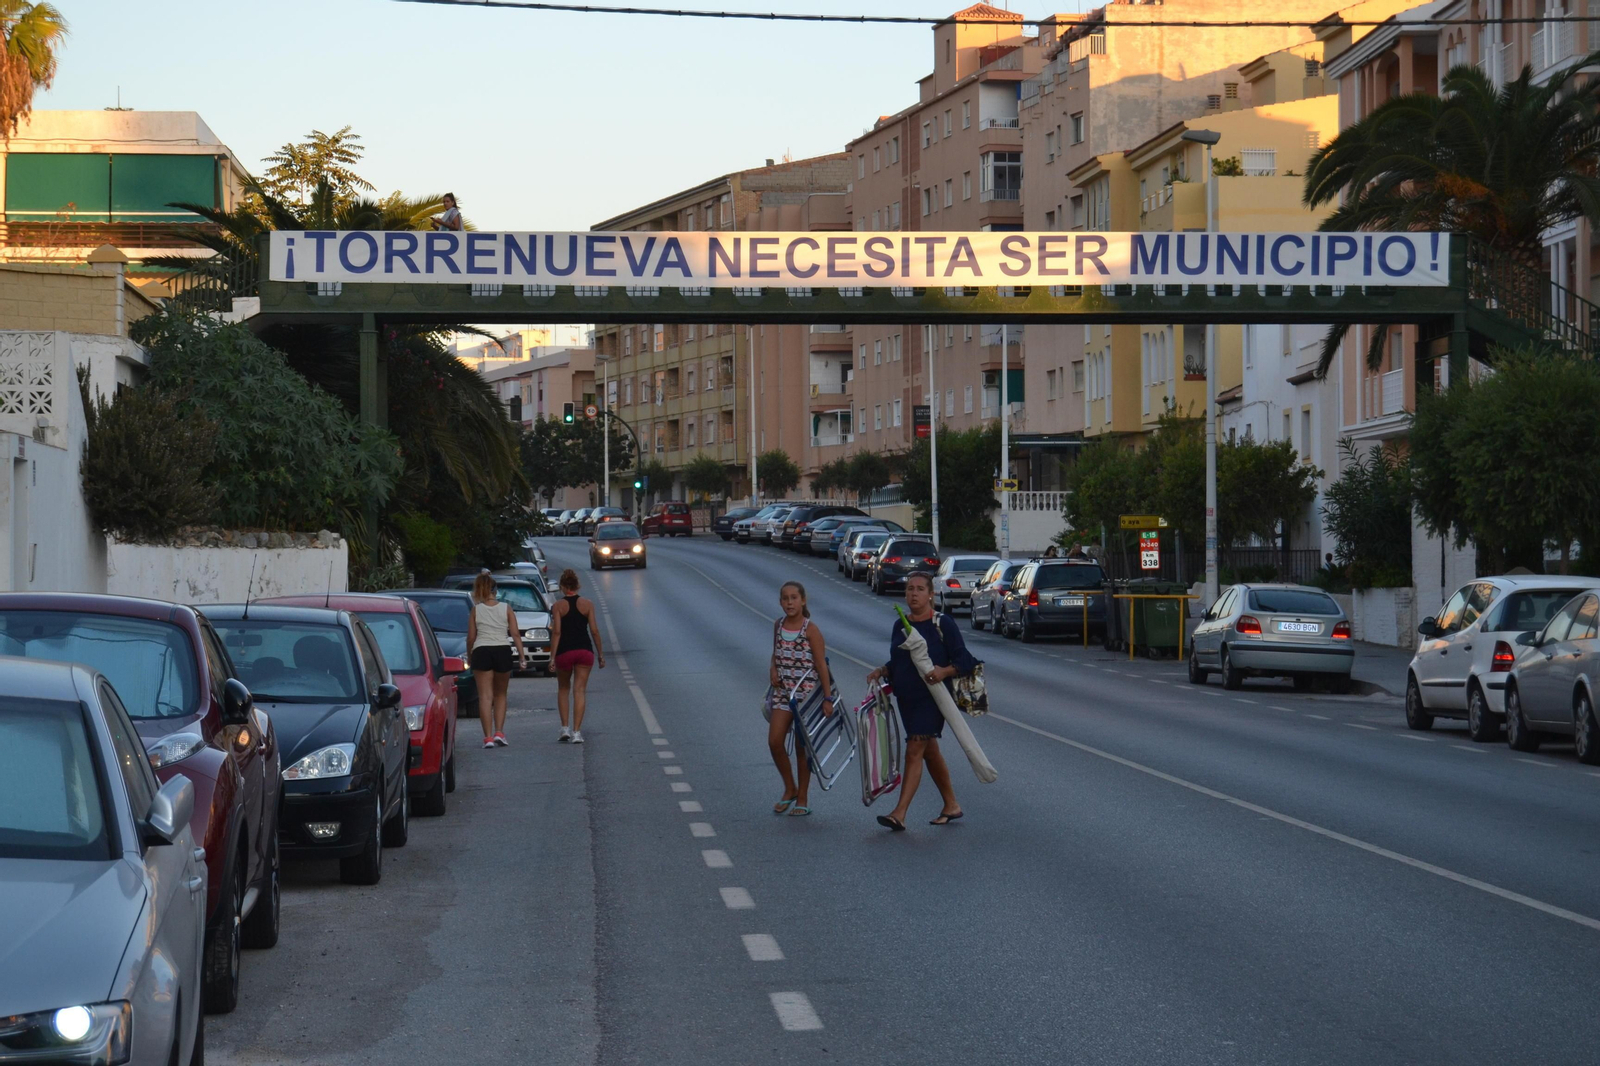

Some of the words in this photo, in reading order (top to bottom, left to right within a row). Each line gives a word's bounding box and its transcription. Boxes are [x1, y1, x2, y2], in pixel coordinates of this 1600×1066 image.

[285, 231, 693, 279] ¡TORRENUEVA
[707, 237, 984, 279] NECESITA
[998, 235, 1111, 277] SER
[1129, 232, 1440, 277] MUNICIPIO!
[1142, 531, 1156, 539] E-15
[1142, 559, 1158, 567] 338
[1283, 623, 1301, 631] 4630
[1302, 623, 1317, 632] BGN
